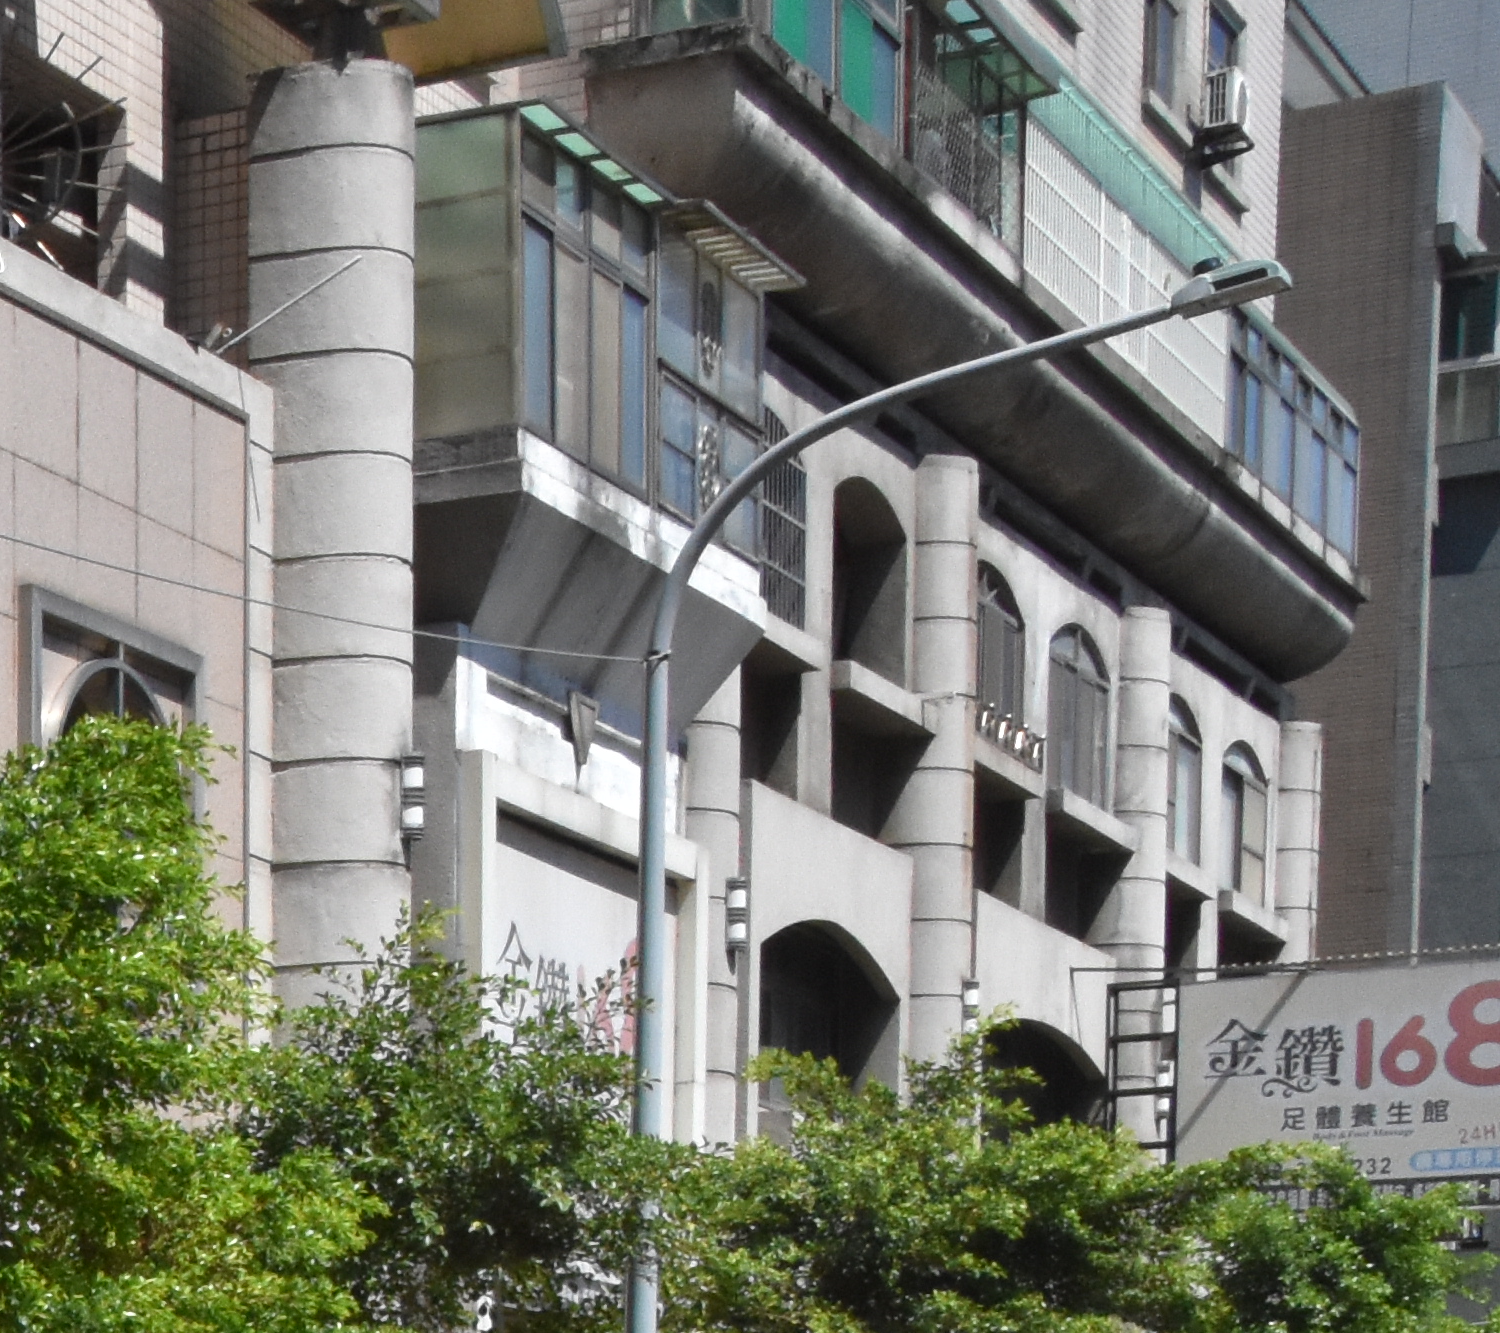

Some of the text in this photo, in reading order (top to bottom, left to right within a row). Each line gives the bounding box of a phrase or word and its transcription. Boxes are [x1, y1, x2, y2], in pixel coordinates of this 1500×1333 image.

[1204, 1018, 1344, 1086] 金鑽
[1281, 1100, 1449, 1132] 足體養生館
